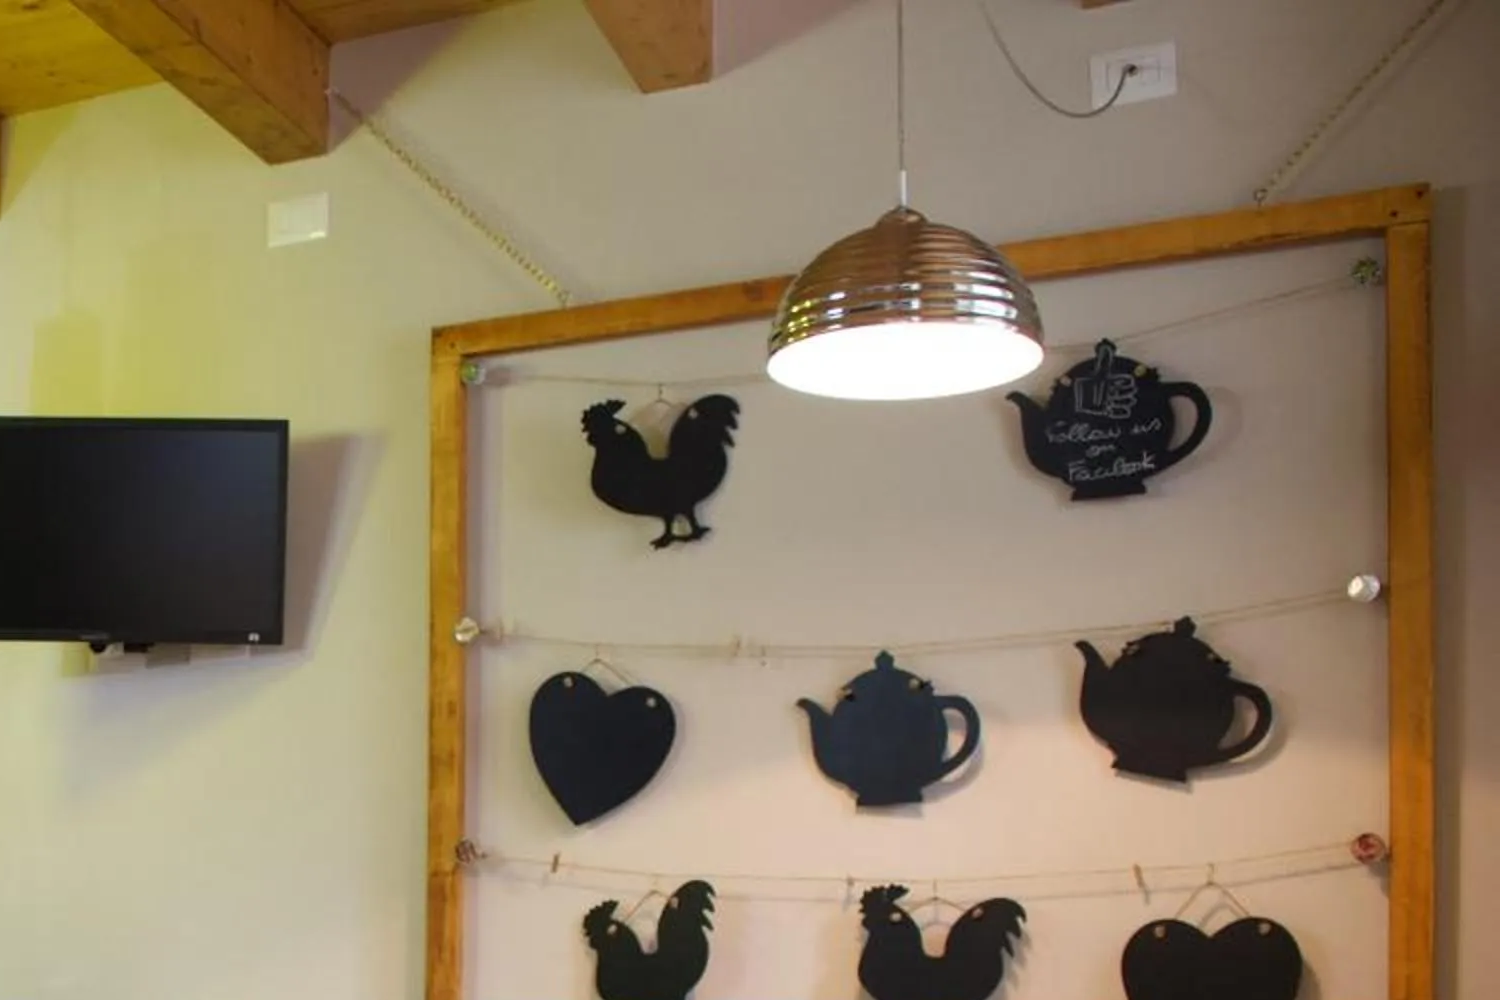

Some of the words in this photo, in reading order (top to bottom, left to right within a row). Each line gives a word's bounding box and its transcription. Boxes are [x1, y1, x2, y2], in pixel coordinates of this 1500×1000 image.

[1046, 420, 1121, 443] Follow
[1130, 417, 1162, 435] us
[1086, 444, 1116, 457] on
